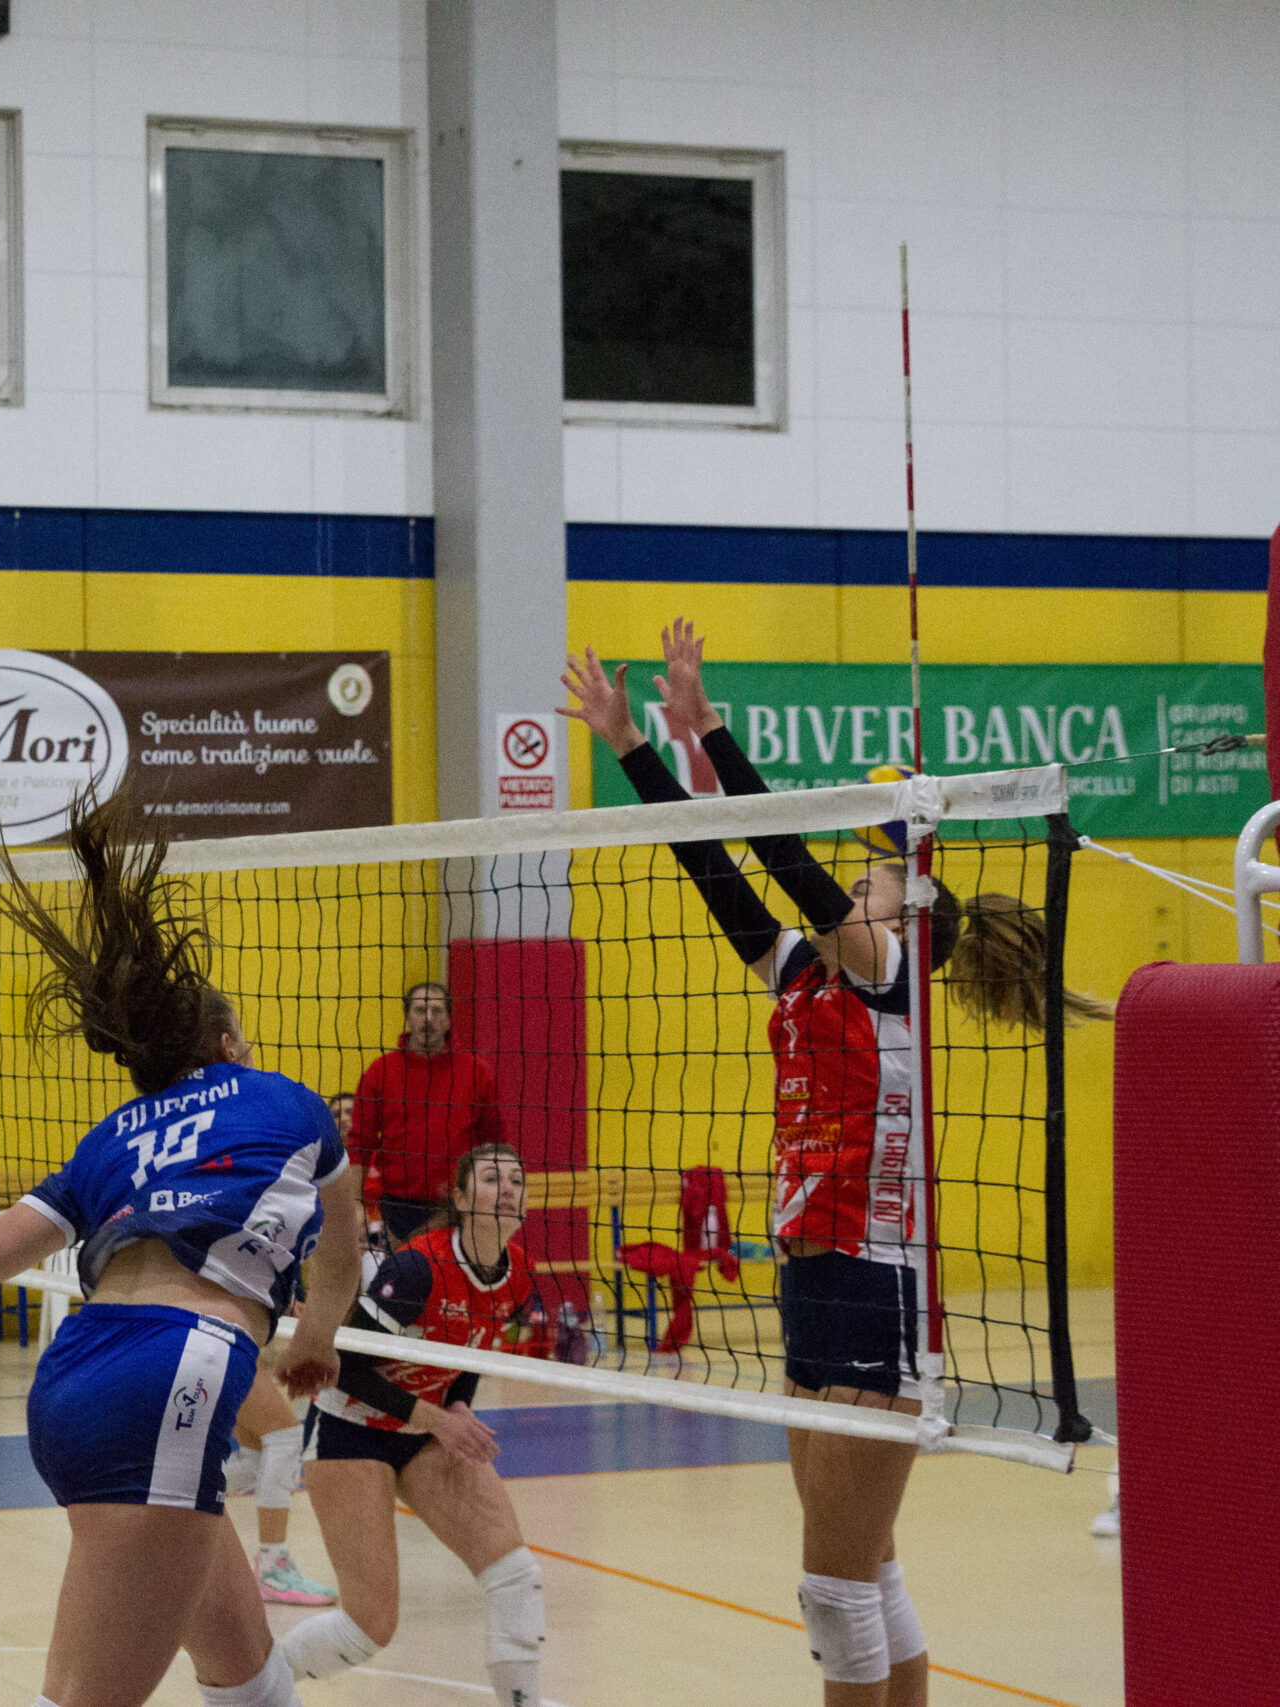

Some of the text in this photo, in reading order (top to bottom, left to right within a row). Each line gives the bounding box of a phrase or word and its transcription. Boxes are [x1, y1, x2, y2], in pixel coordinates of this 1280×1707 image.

[140, 709, 318, 744] Specialità buone
[746, 704, 1130, 765] BIVER BANCA
[141, 750, 196, 765] come
[201, 740, 310, 775] tradizione
[127, 1109, 216, 1191] 10
